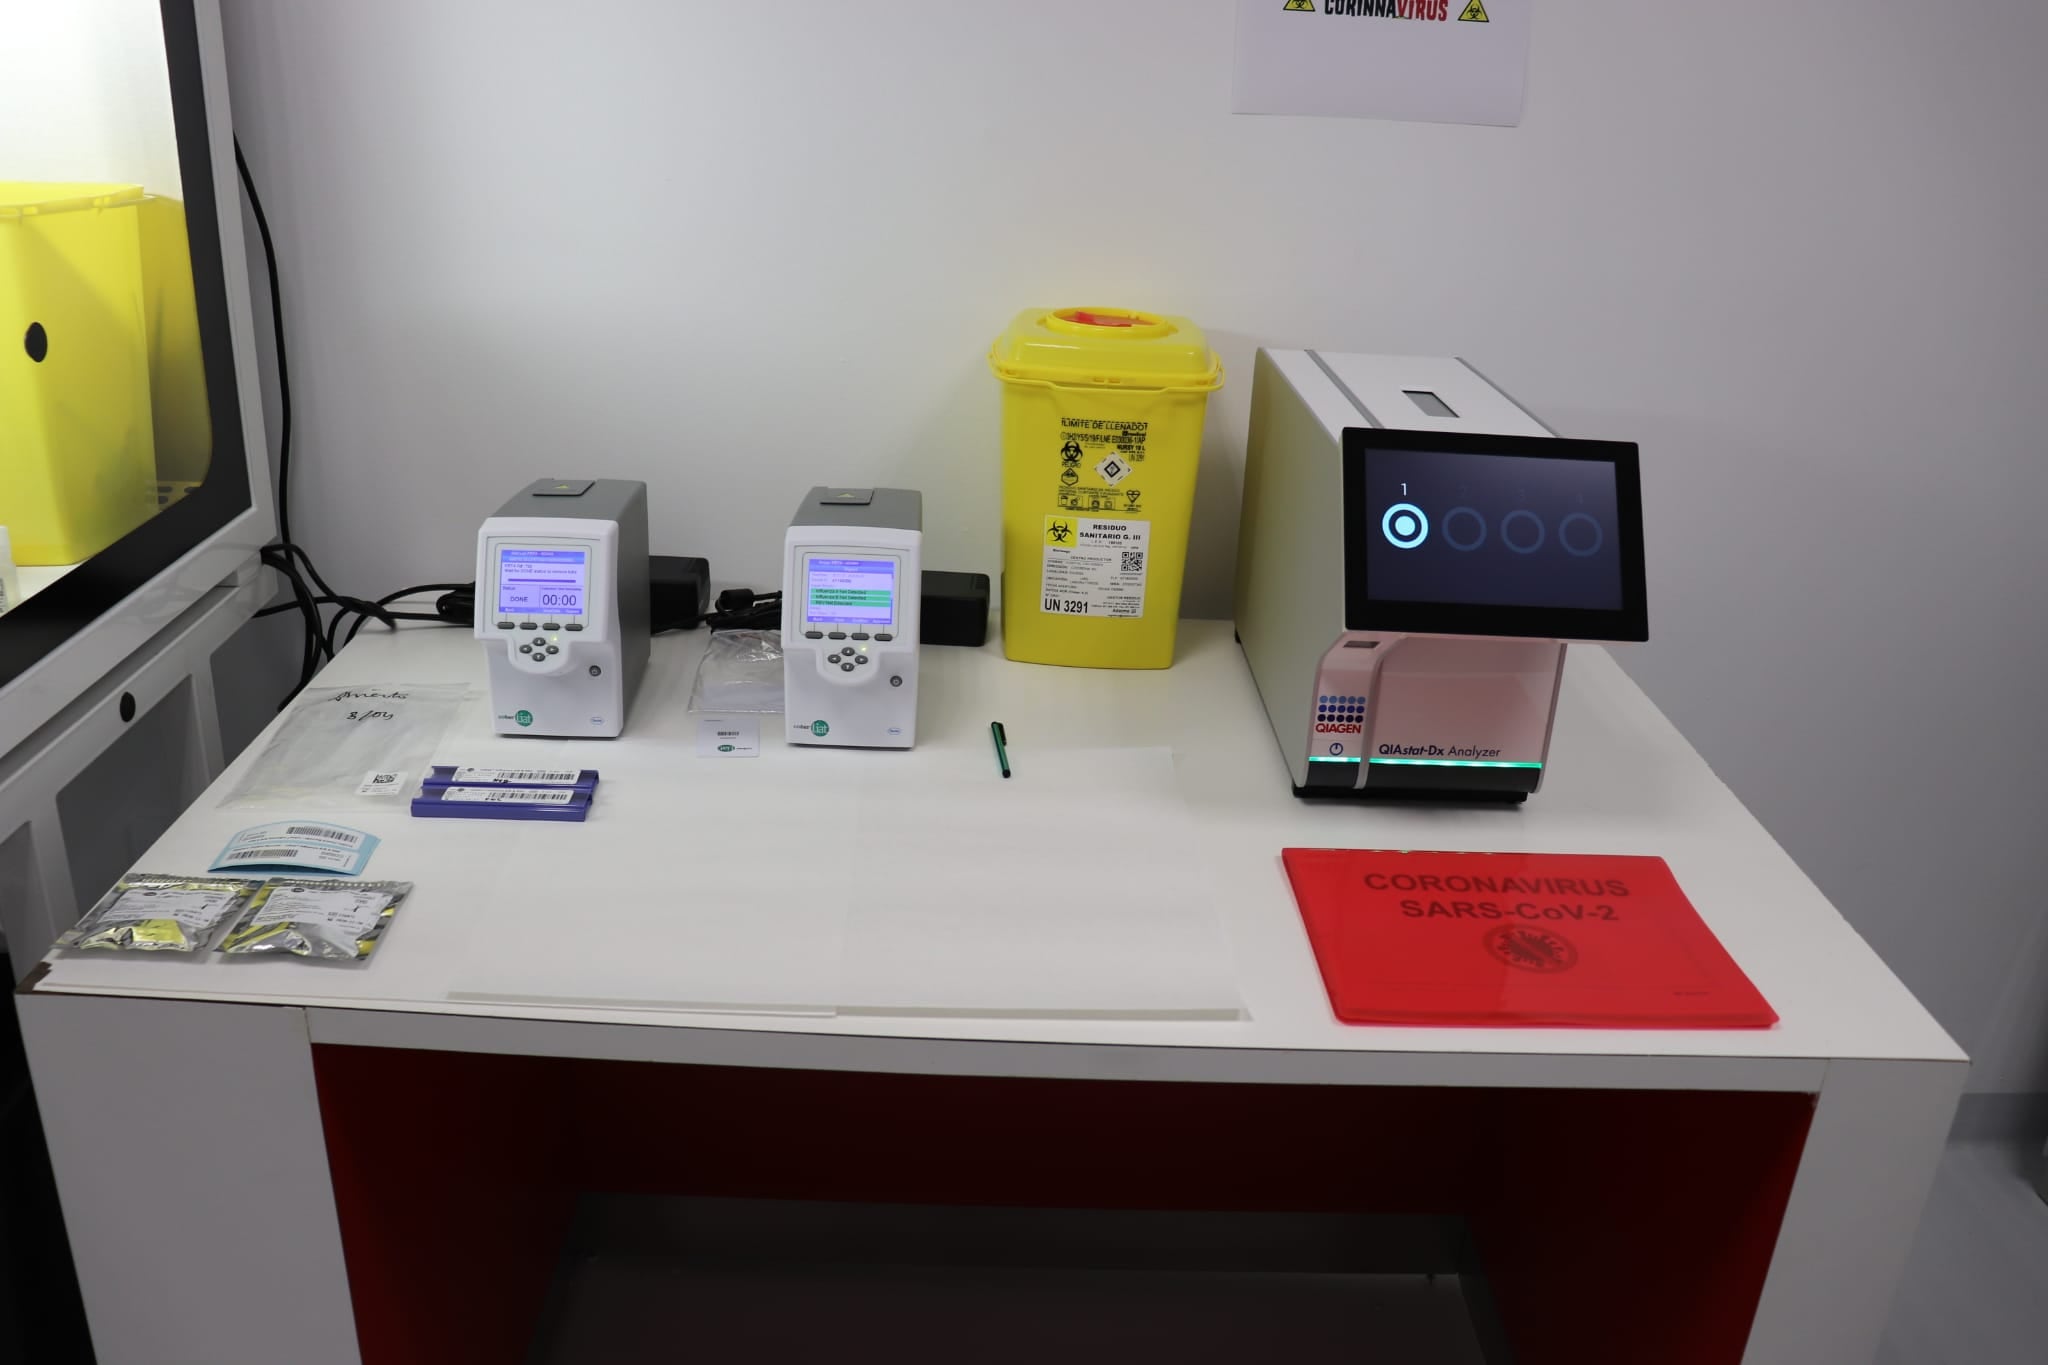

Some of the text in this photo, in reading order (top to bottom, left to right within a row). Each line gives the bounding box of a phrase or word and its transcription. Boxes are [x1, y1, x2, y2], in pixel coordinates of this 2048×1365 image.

[1092, 422, 1103, 430] DE
[1105, 422, 1145, 431] LLENADO
[1401, 482, 1407, 496] 1
[1079, 532, 1121, 540] SANITARIO
[542, 595, 577, 606] 00:00
[1044, 598, 1060, 612] UN
[1063, 600, 1088, 613] 3291
[1315, 723, 1362, 734] QIAGEN
[1378, 743, 1501, 760] QIAstat-Dx Analyzer
[1364, 872, 1630, 897] CORONAVIRUS
[1401, 900, 1620, 922] SARS-CoV-2
